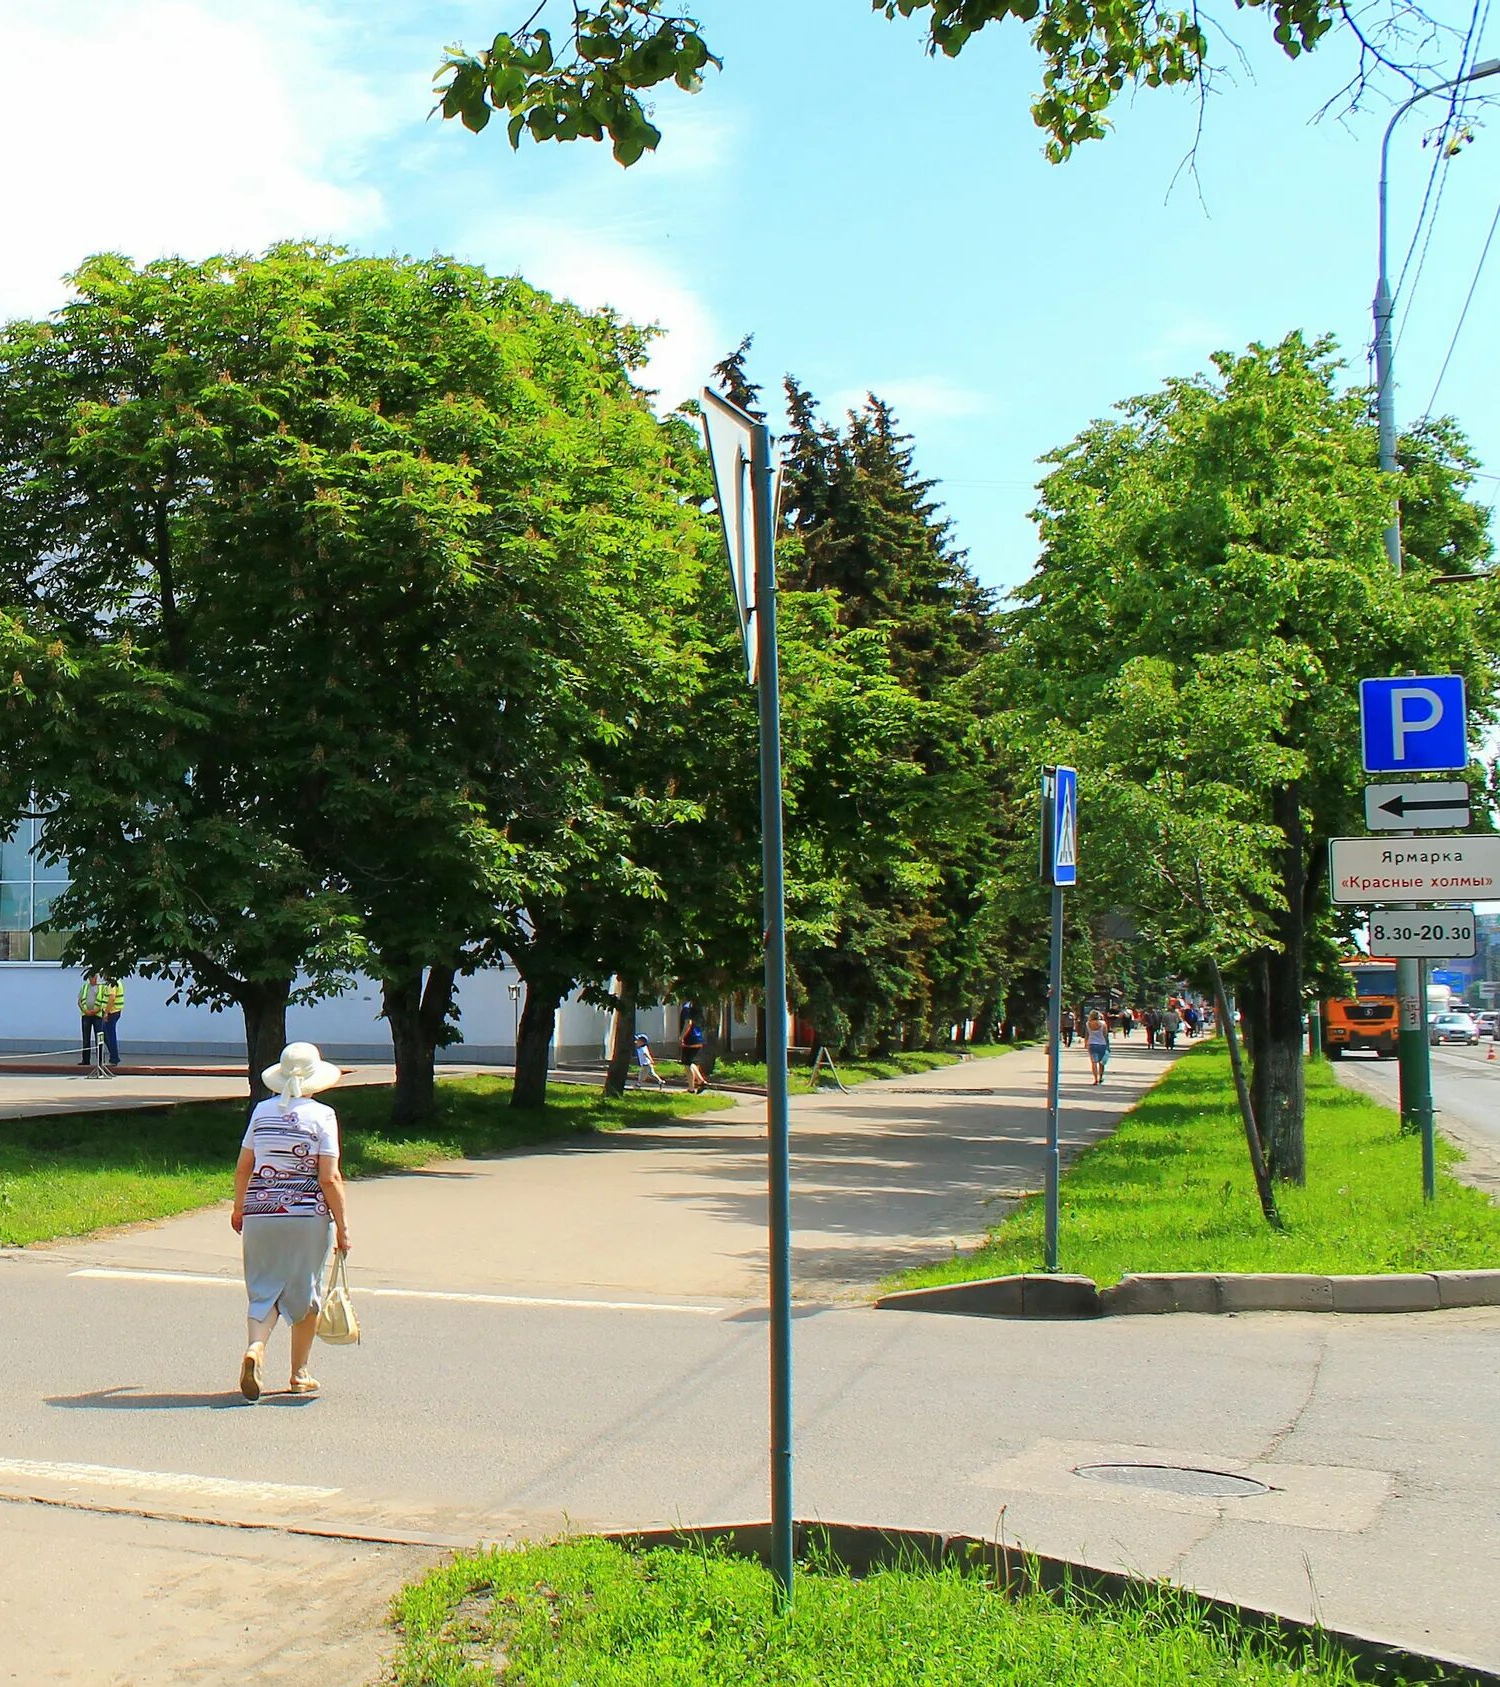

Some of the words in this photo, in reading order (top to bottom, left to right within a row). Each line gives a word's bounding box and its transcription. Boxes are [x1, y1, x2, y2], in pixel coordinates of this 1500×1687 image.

[1391, 687, 1444, 761] P
[1381, 850, 1463, 866] Ярмарка
[1341, 875, 1424, 891] «Красные
[1430, 876, 1493, 888] холмы»
[1374, 925, 1471, 941] 8.30-20.30
